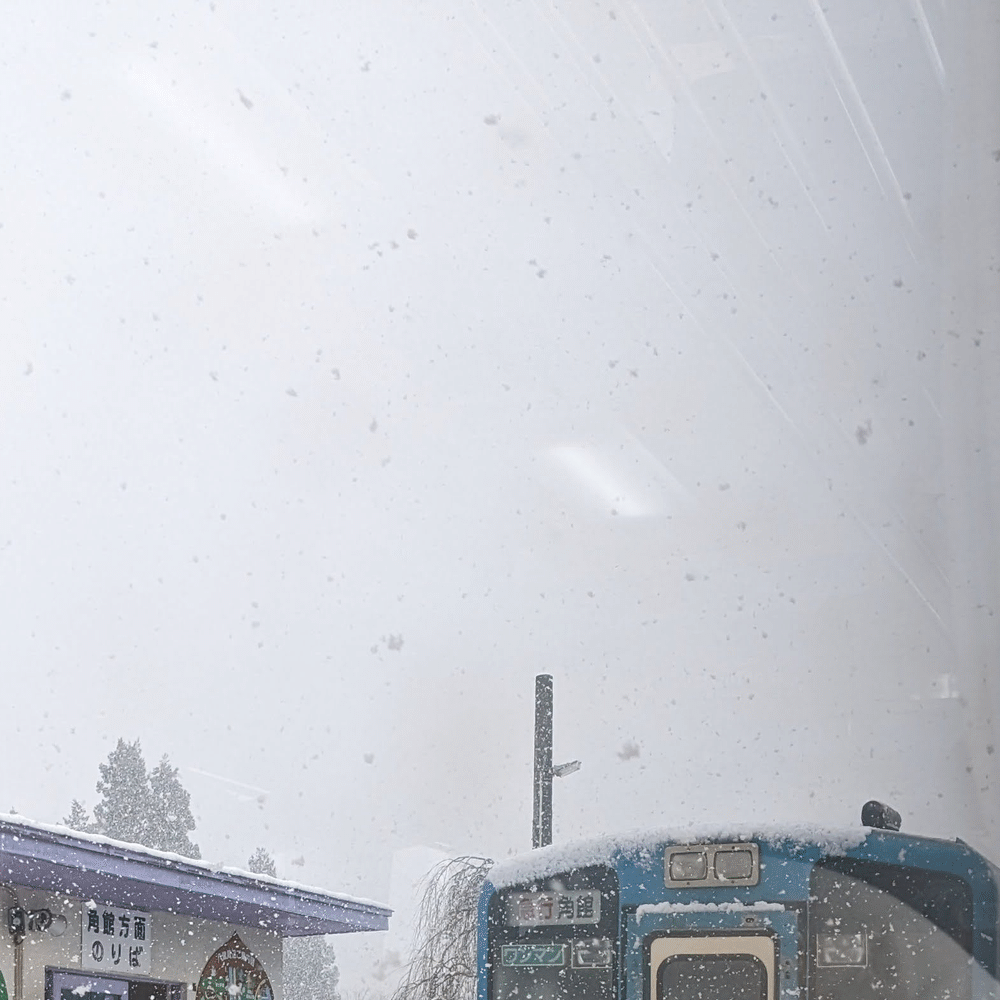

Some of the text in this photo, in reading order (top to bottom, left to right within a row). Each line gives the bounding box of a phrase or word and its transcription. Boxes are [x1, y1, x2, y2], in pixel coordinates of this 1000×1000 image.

[87, 909, 146, 940] 角館方面
[92, 941, 143, 967] のりば
[503, 947, 563, 963] ワンマン
